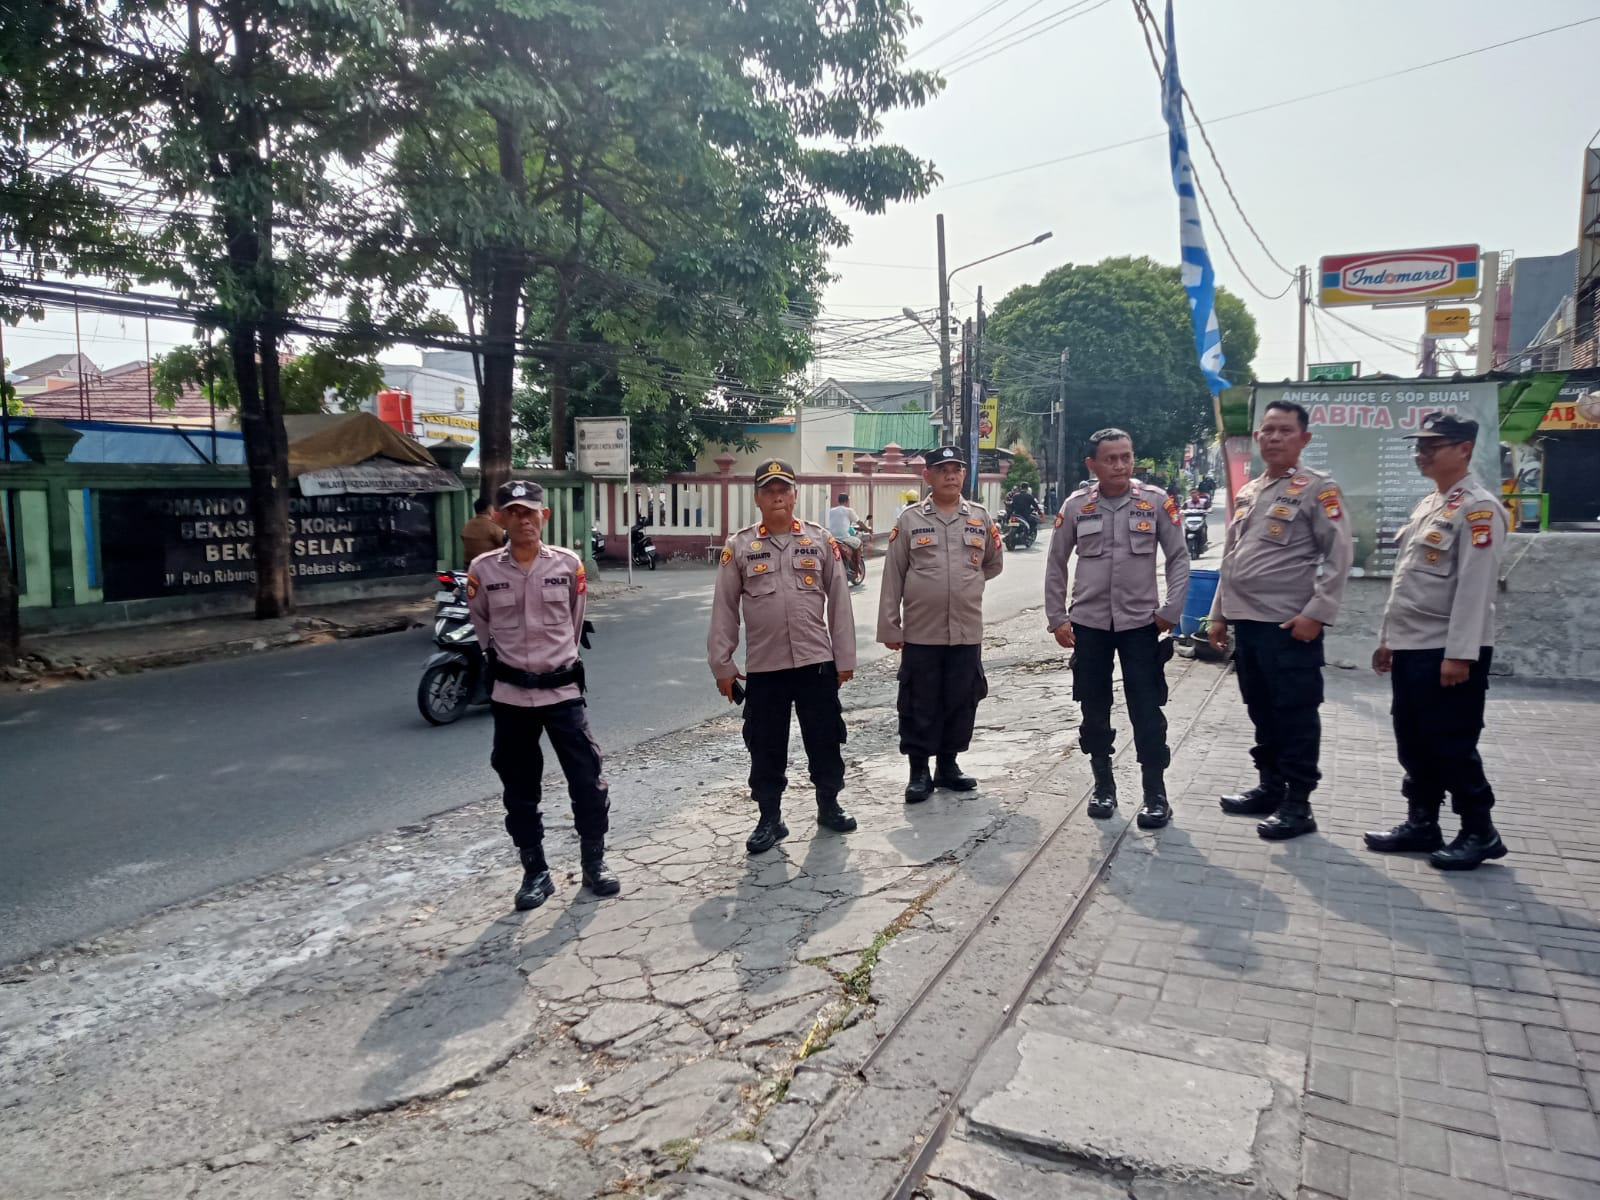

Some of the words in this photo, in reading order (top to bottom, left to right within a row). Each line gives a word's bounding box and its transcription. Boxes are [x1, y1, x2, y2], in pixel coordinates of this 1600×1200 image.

[1348, 265, 1447, 286] Indomaret
[1282, 391, 1329, 402] ANEKA
[1335, 392, 1377, 402] JUICE
[1381, 392, 1392, 403] &
[1397, 391, 1424, 402] SOP
[1429, 391, 1470, 402] BUAH
[1306, 404, 1393, 430] ABITA
[1275, 495, 1302, 506] POLRI
[1130, 510, 1155, 519] POLRI
[964, 526, 986, 536] POLRI
[794, 547, 819, 556] POLRI
[298, 560, 337, 576] Bekasi
